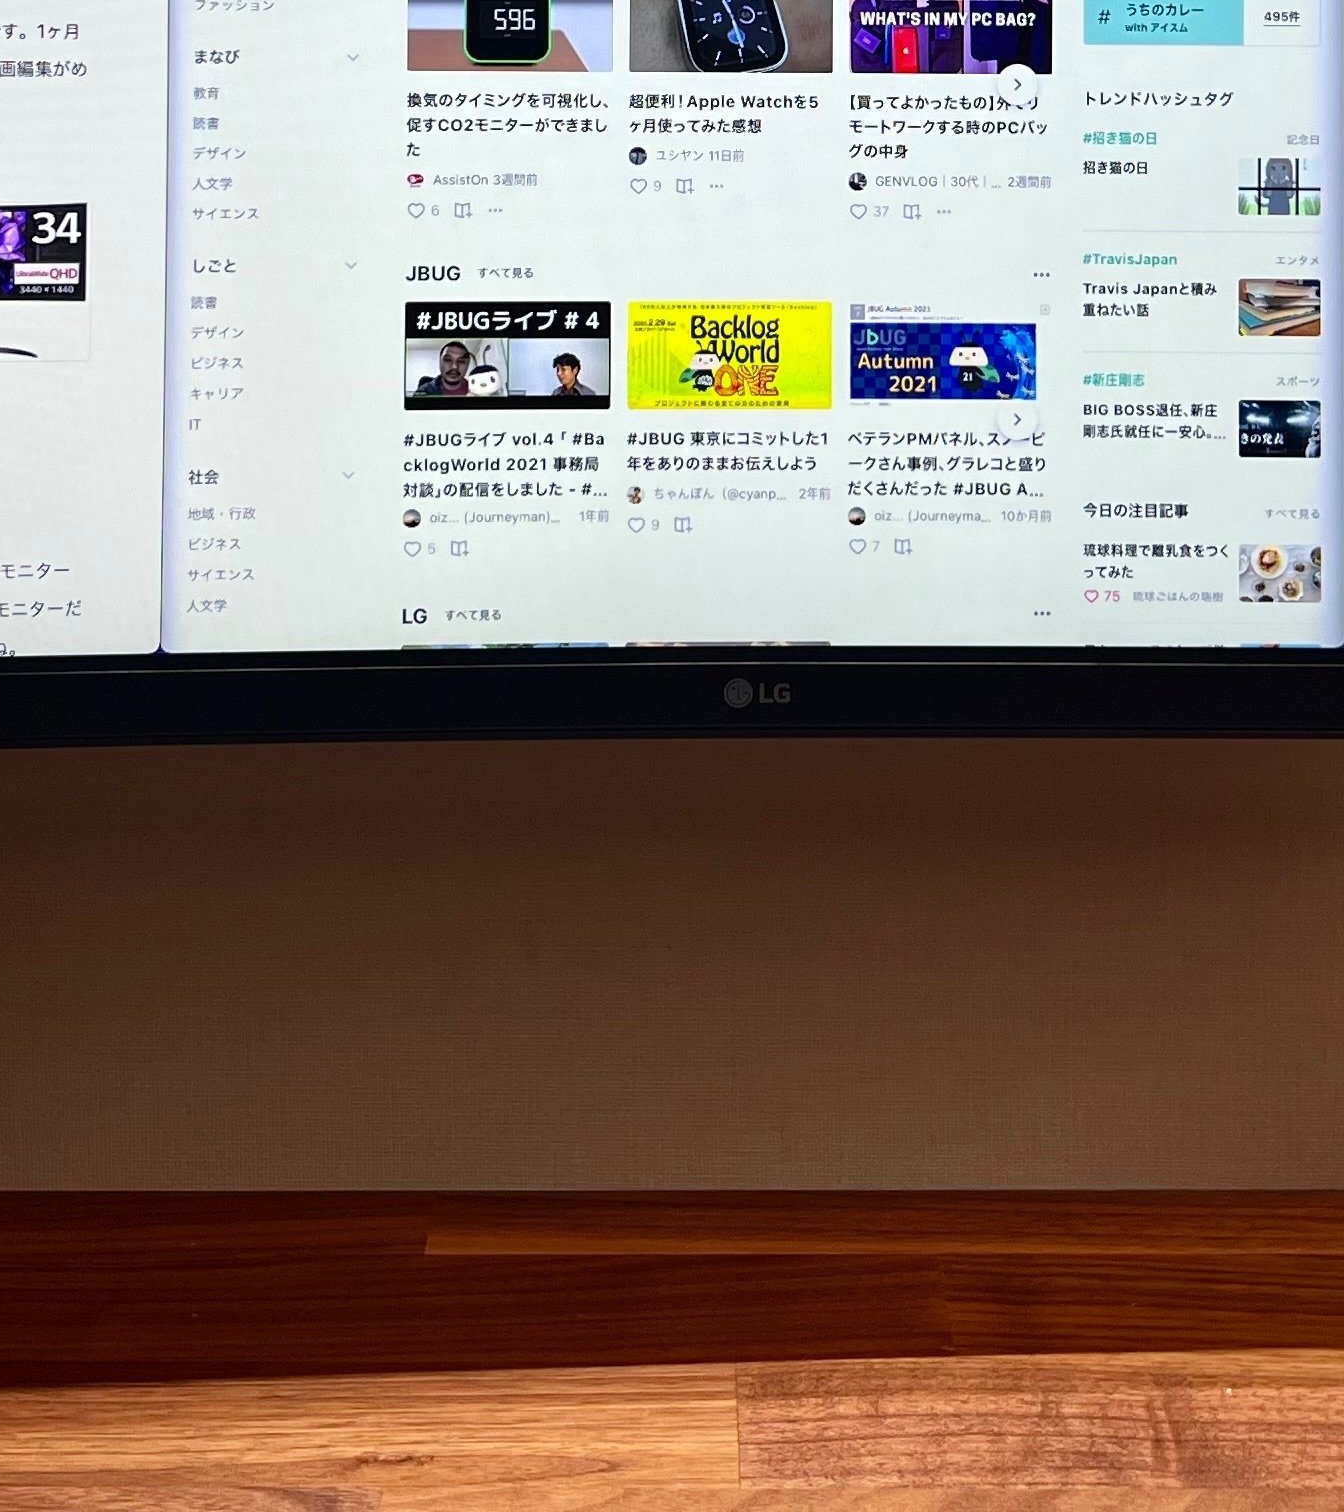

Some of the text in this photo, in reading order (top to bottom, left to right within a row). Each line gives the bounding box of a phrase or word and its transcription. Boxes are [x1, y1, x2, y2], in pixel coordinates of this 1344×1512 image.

[1127, 3, 1204, 16] うちのカレー
[494, 9, 535, 30] 596
[860, 11, 1036, 27] WHAT'S IN MY PC BAG?
[195, 50, 240, 64] まなび
[1087, 92, 1233, 106] トレンドハッシュタグ
[31, 211, 82, 244] 34
[194, 259, 236, 273] しごと
[1083, 254, 1177, 267] #TravisJapan
[49, 268, 78, 280] QHD
[406, 266, 460, 281] JBUG
[417, 310, 599, 330] #JBUGライブ # 4
[690, 314, 780, 343] Backlog
[857, 352, 935, 372] Autumn
[889, 373, 938, 394] 2021
[189, 470, 218, 484] 社会
[1084, 503, 1188, 518] 今日の注目記事
[403, 608, 427, 624] LG
[760, 683, 791, 704] LG
